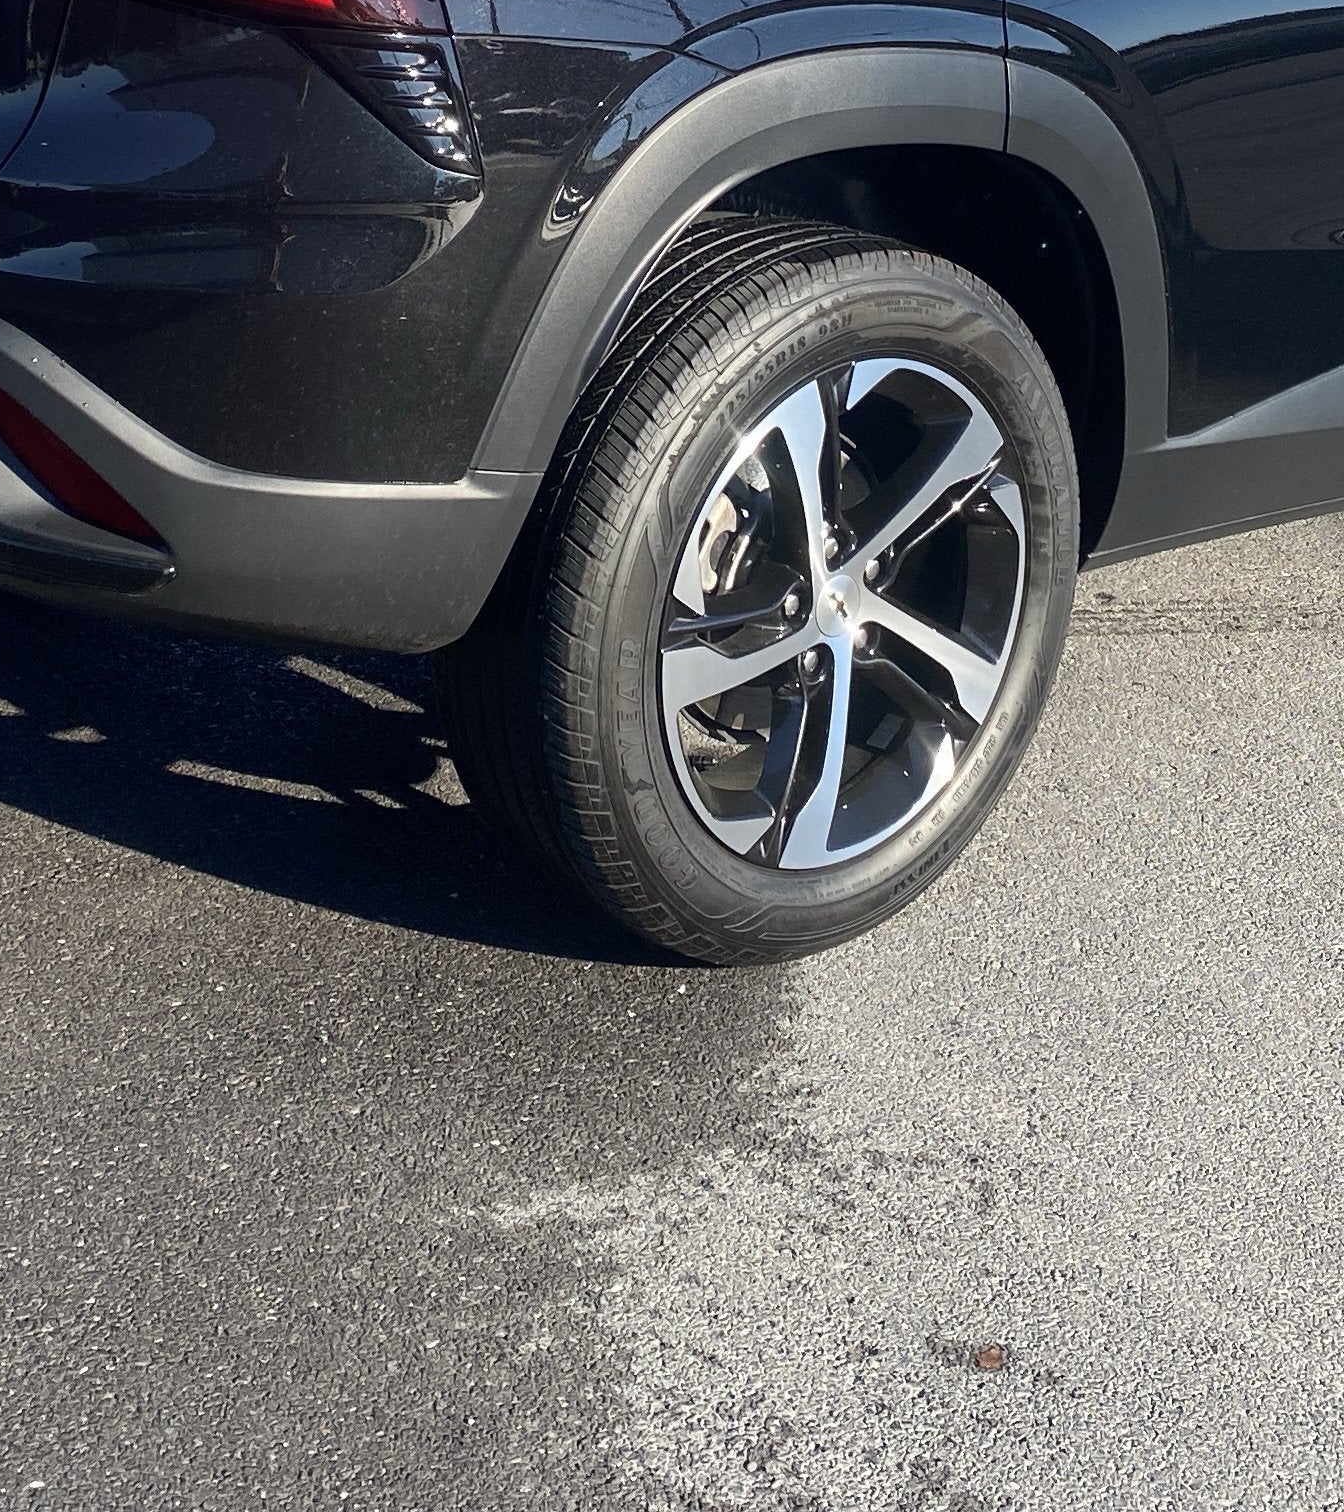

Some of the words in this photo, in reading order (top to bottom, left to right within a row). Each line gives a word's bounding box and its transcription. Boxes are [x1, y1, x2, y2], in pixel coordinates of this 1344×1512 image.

[817, 311, 854, 338] 98H
[1012, 371, 1073, 589] ASSURANCE
[616, 638, 700, 891] GOODYEAR
